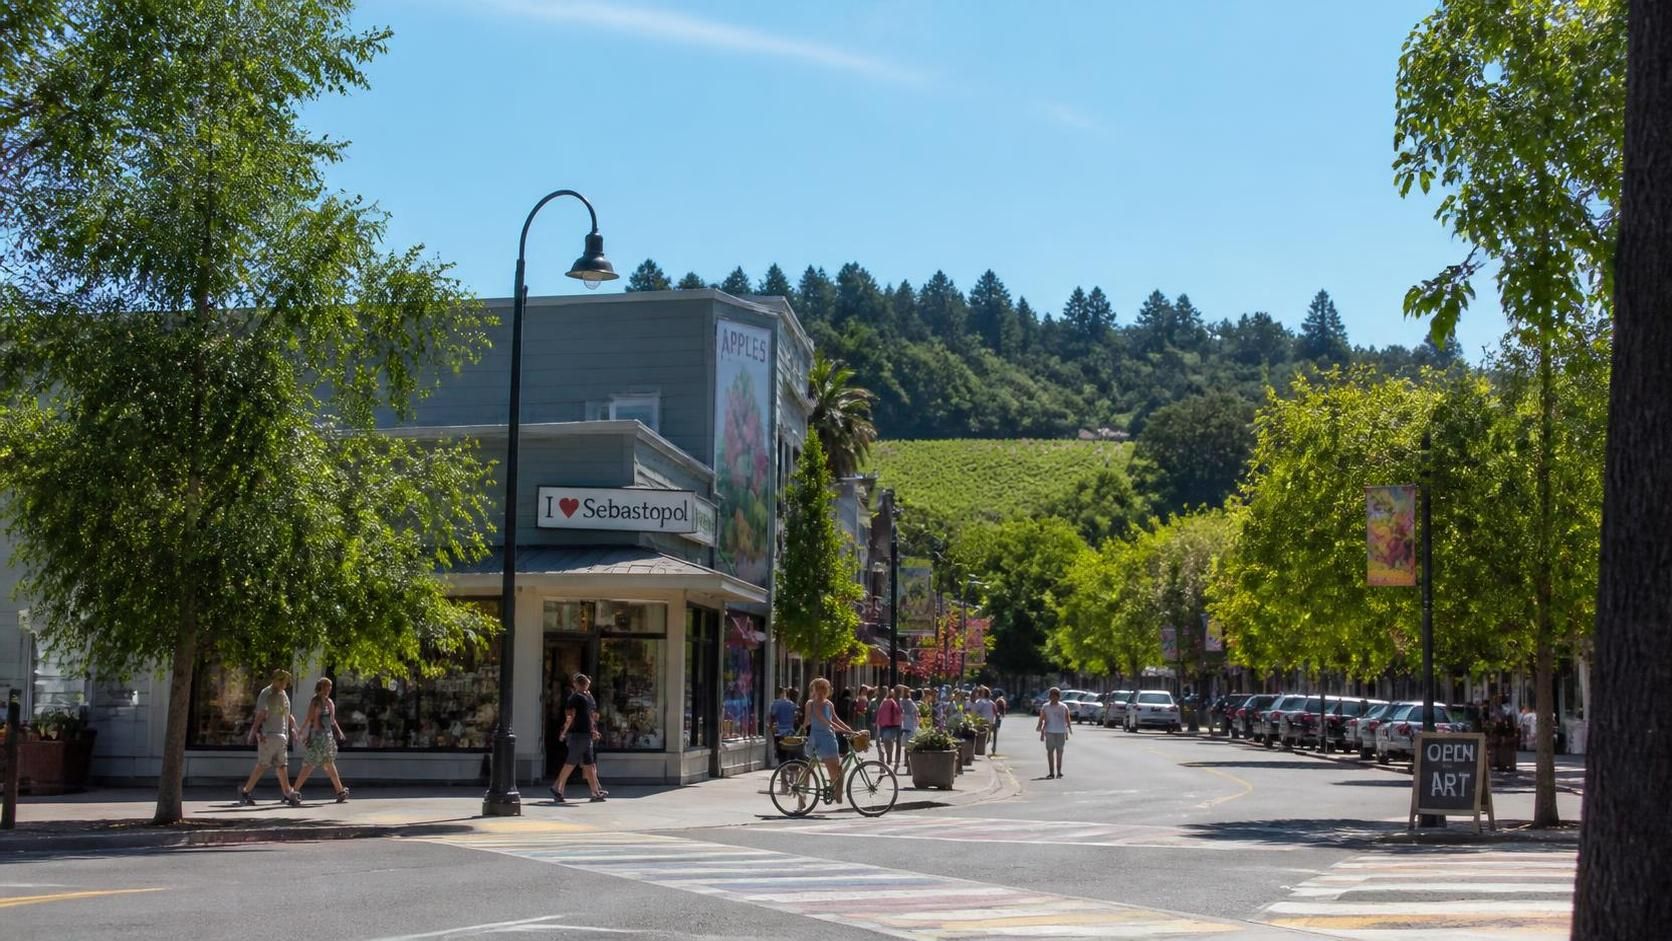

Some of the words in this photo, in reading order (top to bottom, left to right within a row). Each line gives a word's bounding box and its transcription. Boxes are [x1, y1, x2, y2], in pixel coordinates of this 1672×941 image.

[720, 328, 767, 363] APPLES
[545, 496, 554, 518] I
[583, 498, 688, 528] Sebastopol
[1431, 771, 1471, 797] ART
